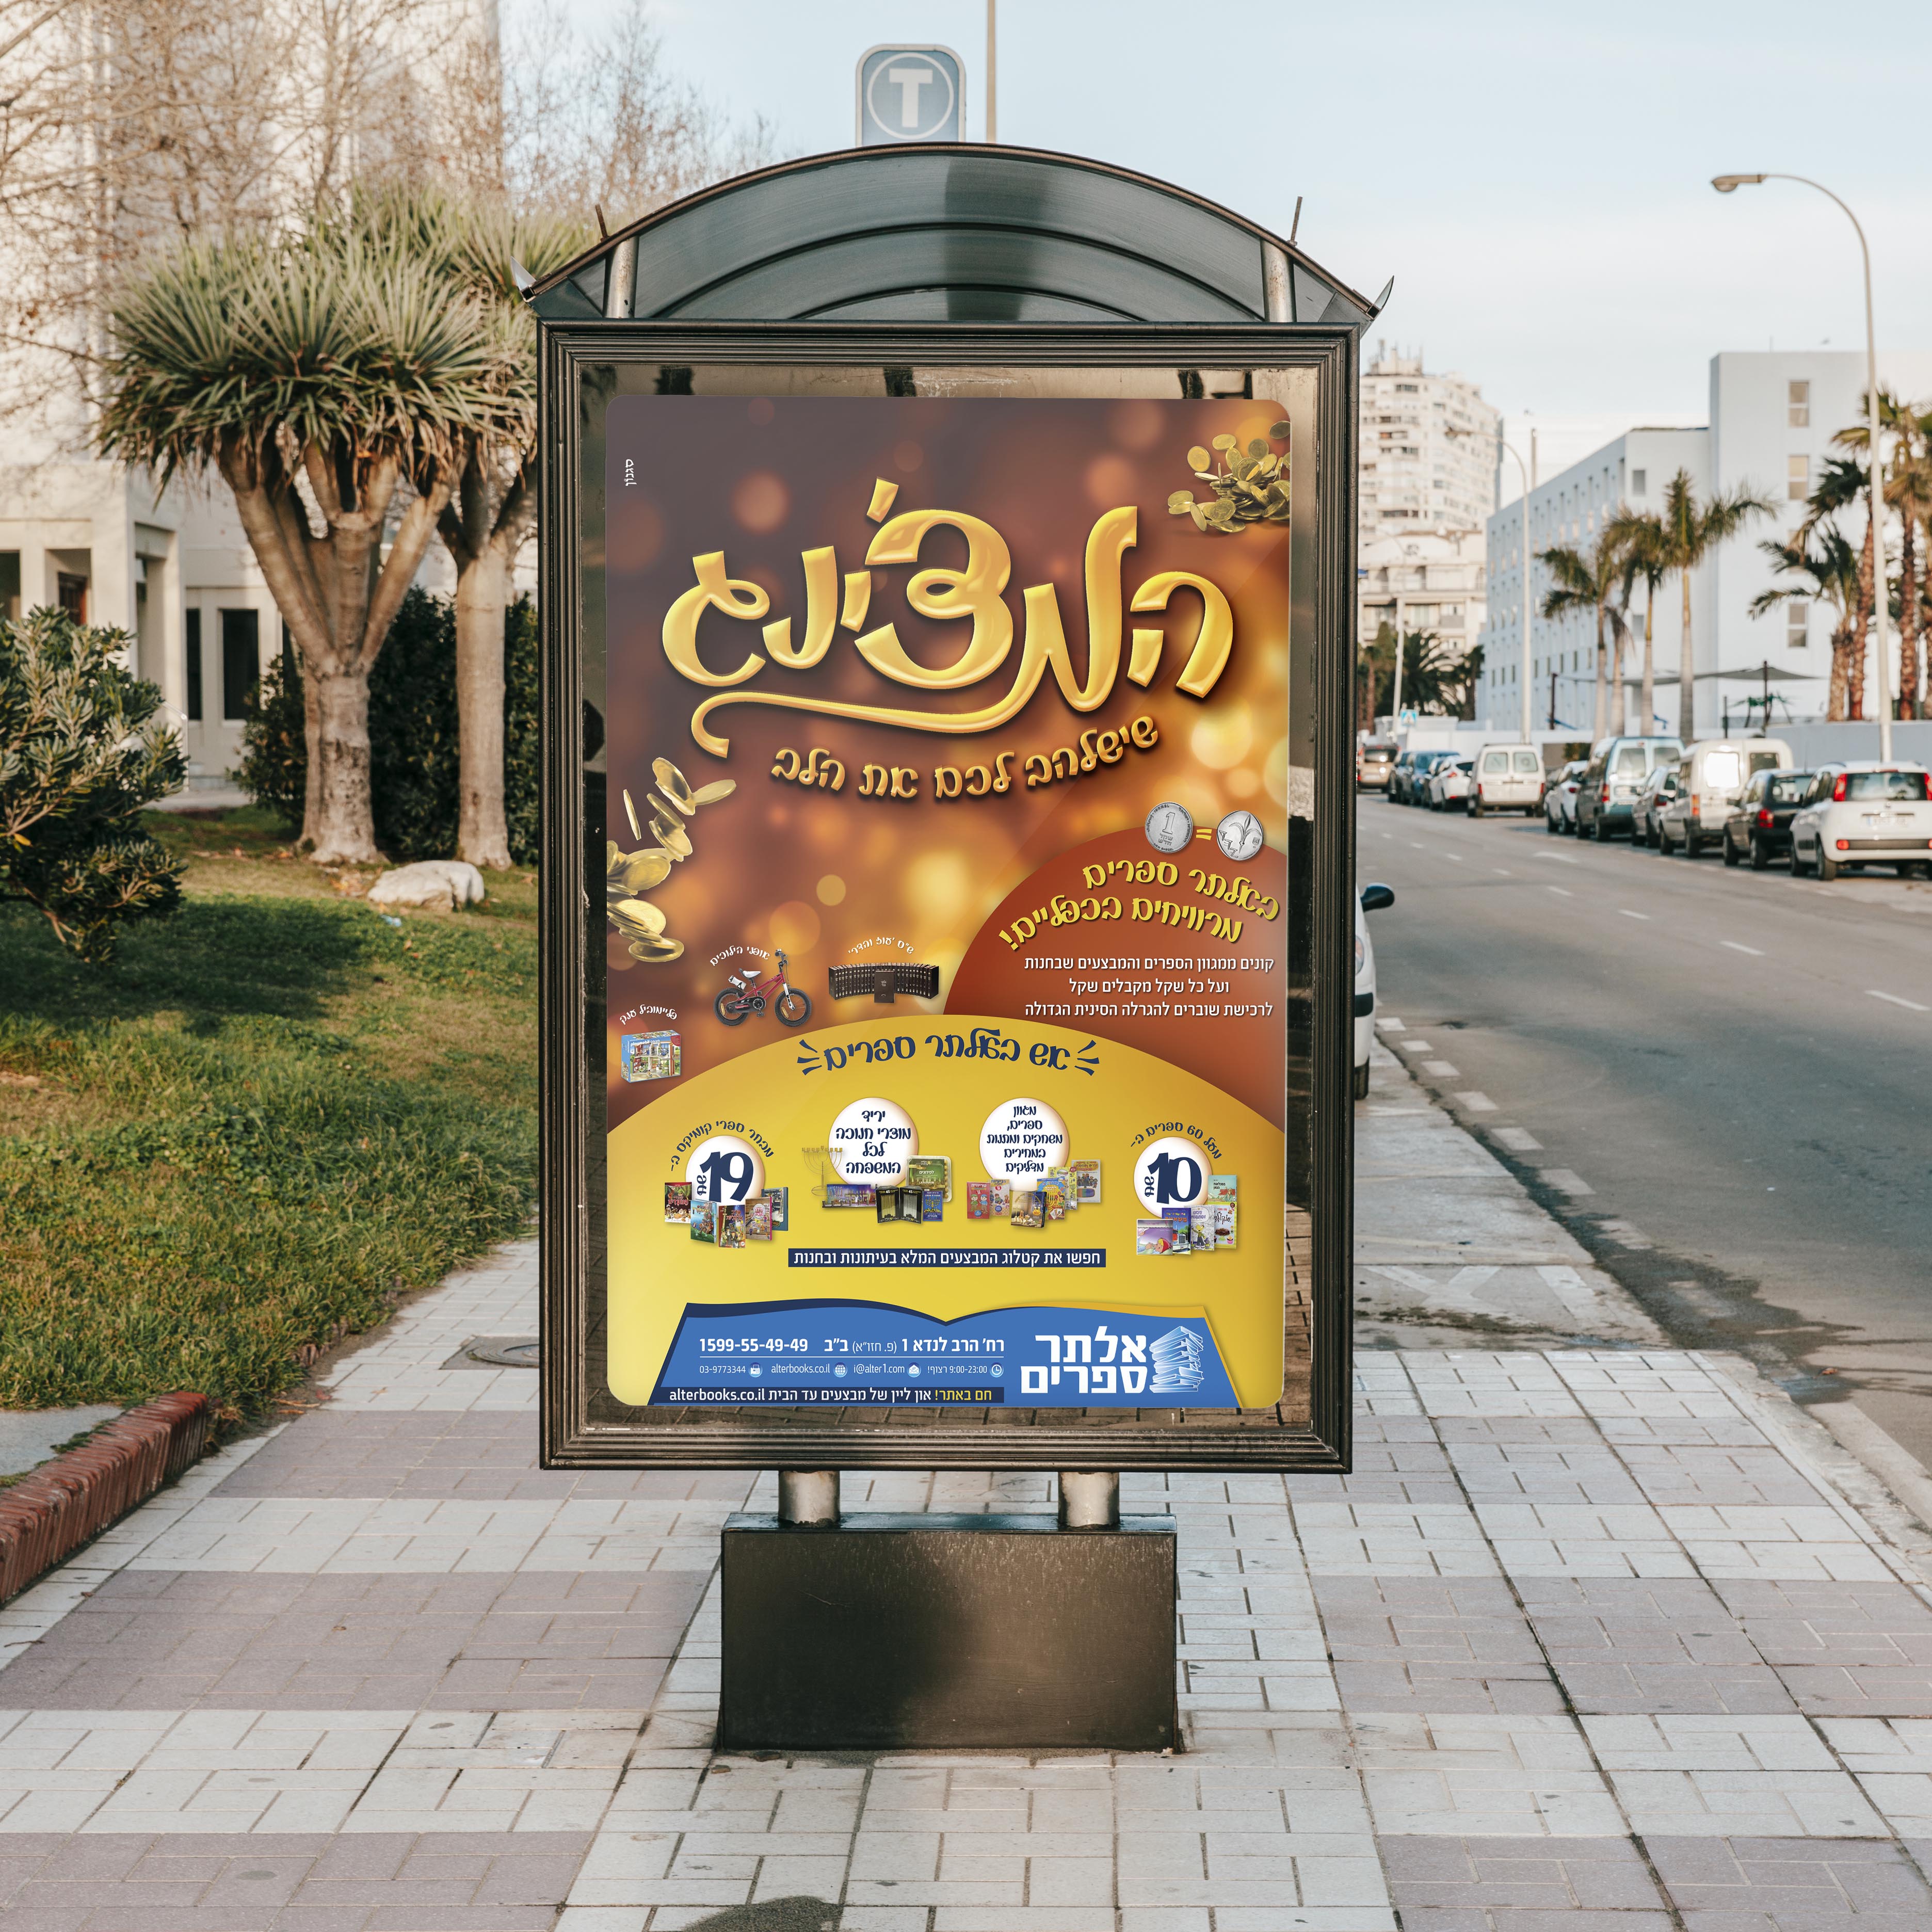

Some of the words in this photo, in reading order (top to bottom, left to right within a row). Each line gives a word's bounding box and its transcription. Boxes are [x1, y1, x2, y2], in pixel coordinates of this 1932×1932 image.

[889, 68, 933, 128] T
[623, 458, 637, 487] סגנון
[1025, 716, 1158, 788] שישלהב
[770, 747, 846, 792] הלב
[935, 751, 1015, 798] לכם
[859, 762, 919, 798] את
[1162, 811, 1176, 835] 1
[1083, 860, 1179, 889] ספרים
[1188, 868, 1279, 921] באלתר
[999, 894, 1122, 951] בכפליים!
[1132, 897, 1242, 942] מרוויחים
[710, 945, 743, 967] הילוכים
[747, 946, 770, 960] אופני
[1024, 958, 1073, 969] שבחנות
[1078, 958, 1140, 969] והמבצעים
[1145, 958, 1193, 969] הספרים
[1197, 958, 1236, 970] ממגוון
[1241, 958, 1274, 970] קונים
[1069, 978, 1098, 995] שקל
[1102, 978, 1151, 995] מקבלים
[1155, 978, 1184, 995] שקל
[1188, 978, 1204, 992] כל
[1208, 978, 1229, 992] ועל
[1025, 1001, 1070, 1016] הגדולה
[1074, 1005, 1117, 1016] הסינית
[1122, 1002, 1170, 1016] להגרלה
[1174, 1005, 1219, 1016] שוברים
[1223, 1002, 1273, 1016] לרכישת
[620, 1009, 636, 1025] ענק
[925, 1027, 1020, 1061] באלתר
[824, 1036, 915, 1072] ספרים
[1029, 1043, 1071, 1070] אש
[861, 1110, 886, 1122] יריד
[1013, 1105, 1037, 1118] מגוון
[715, 1120, 745, 1133] ספרי
[1007, 1120, 1042, 1131] ספרים,
[1146, 1122, 1183, 1137] ספרים
[1187, 1125, 1203, 1139] 60
[677, 1122, 712, 1152] קומיקס
[836, 1128, 873, 1139] חנוכה
[877, 1128, 911, 1139] מוצרי
[987, 1134, 1020, 1144] ומתנות
[1023, 1134, 1062, 1147] משחקים
[749, 1129, 774, 1158] מבחר
[862, 1141, 888, 1157] לכל
[1203, 1137, 1222, 1160] מעל
[1004, 1148, 1046, 1158] במחירים
[846, 1162, 901, 1174] המשפחה
[1006, 1160, 1044, 1175] מדליקים
[700, 1151, 753, 1202] 19
[1148, 1152, 1202, 1204] 10
[794, 1253, 836, 1264] ובחנות
[840, 1253, 897, 1264] בעיתונות
[901, 1250, 936, 1264] המלא
[941, 1253, 997, 1264] המבצעים
[1002, 1250, 1040, 1267] קטלוג
[1043, 1253, 1062, 1264] את
[1066, 1253, 1100, 1264] חפשו
[700, 1338, 808, 1352] 1599-55-49-49
[824, 1338, 849, 1351] ב"ב
[902, 1339, 908, 1351] 1
[913, 1337, 948, 1351] לנדא
[951, 1339, 979, 1351] הרב
[983, 1338, 1004, 1351] רח'
[1035, 1326, 1147, 1363] אלתר
[771, 1363, 830, 1373] alterbooks.co.il
[854, 1363, 905, 1374] i@alter1.com
[927, 1365, 947, 1375] רצוף!
[1020, 1365, 1148, 1393] ספרים
[669, 1388, 765, 1400] alterbooks.co.il
[768, 1390, 798, 1400] הבית
[801, 1390, 817, 1400] עד
[821, 1390, 866, 1400] מבצעים
[870, 1387, 888, 1400] של
[891, 1387, 911, 1403] ליין
[914, 1390, 931, 1403] און
[935, 1390, 971, 1400] באתר!
[975, 1390, 992, 1400] חם
